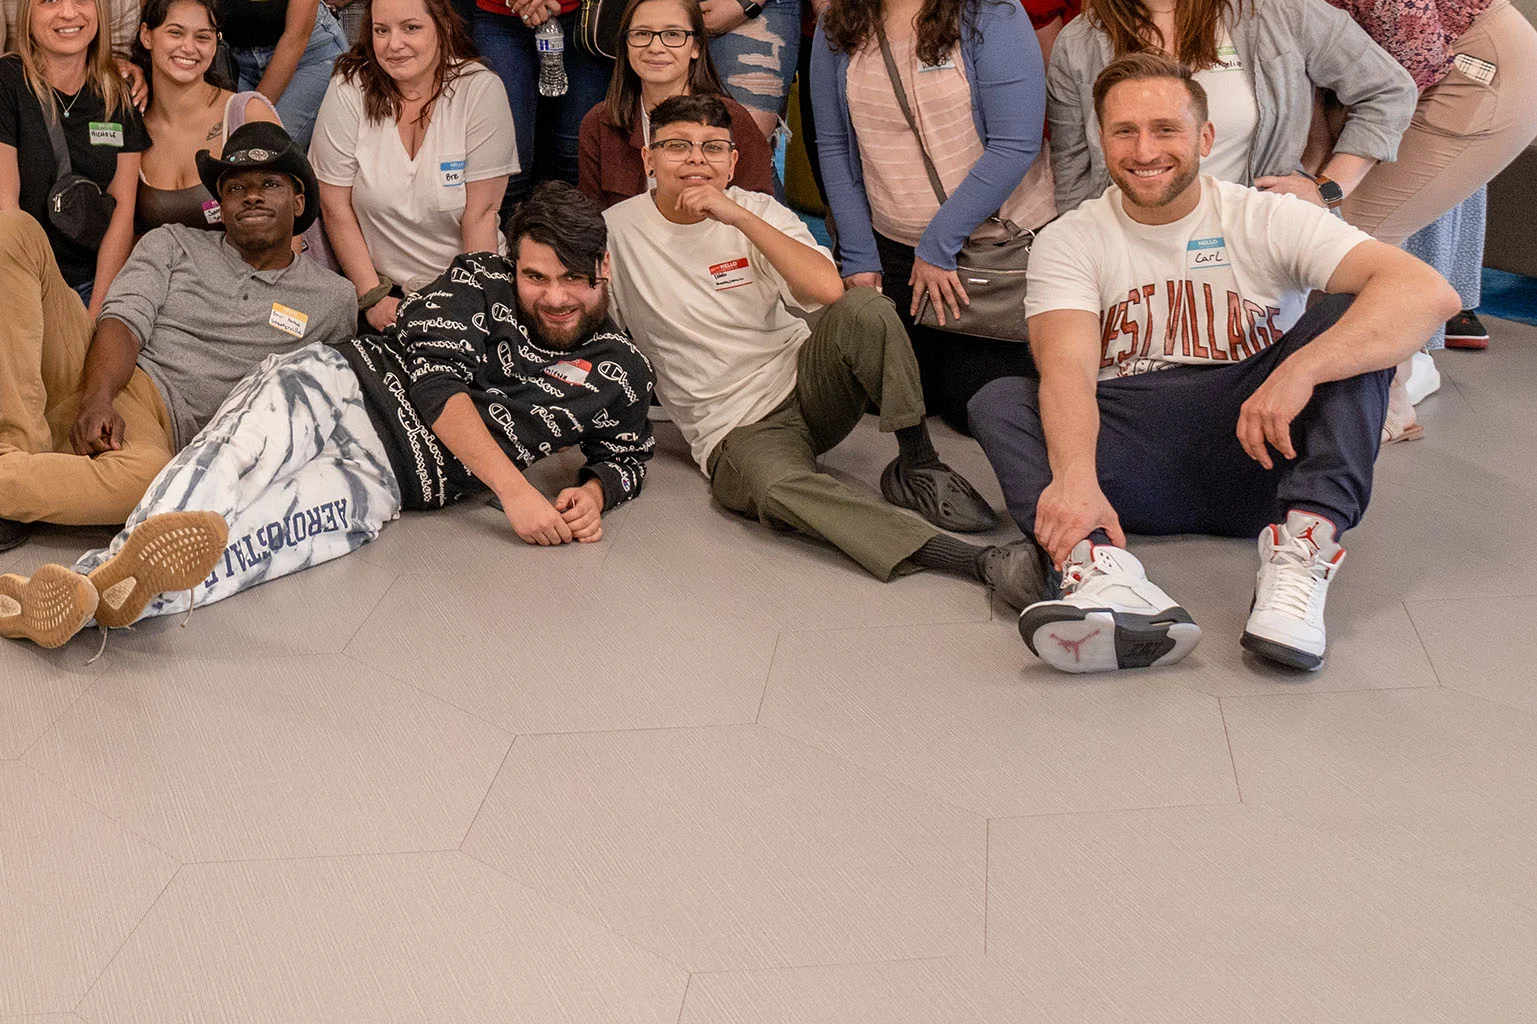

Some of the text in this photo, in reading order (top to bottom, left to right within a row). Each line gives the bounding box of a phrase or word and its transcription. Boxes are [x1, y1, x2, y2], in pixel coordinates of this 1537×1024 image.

[719, 261, 738, 270] HELLO
[1164, 279, 1285, 362] VILLAGE
[383, 372, 445, 466] Champion
